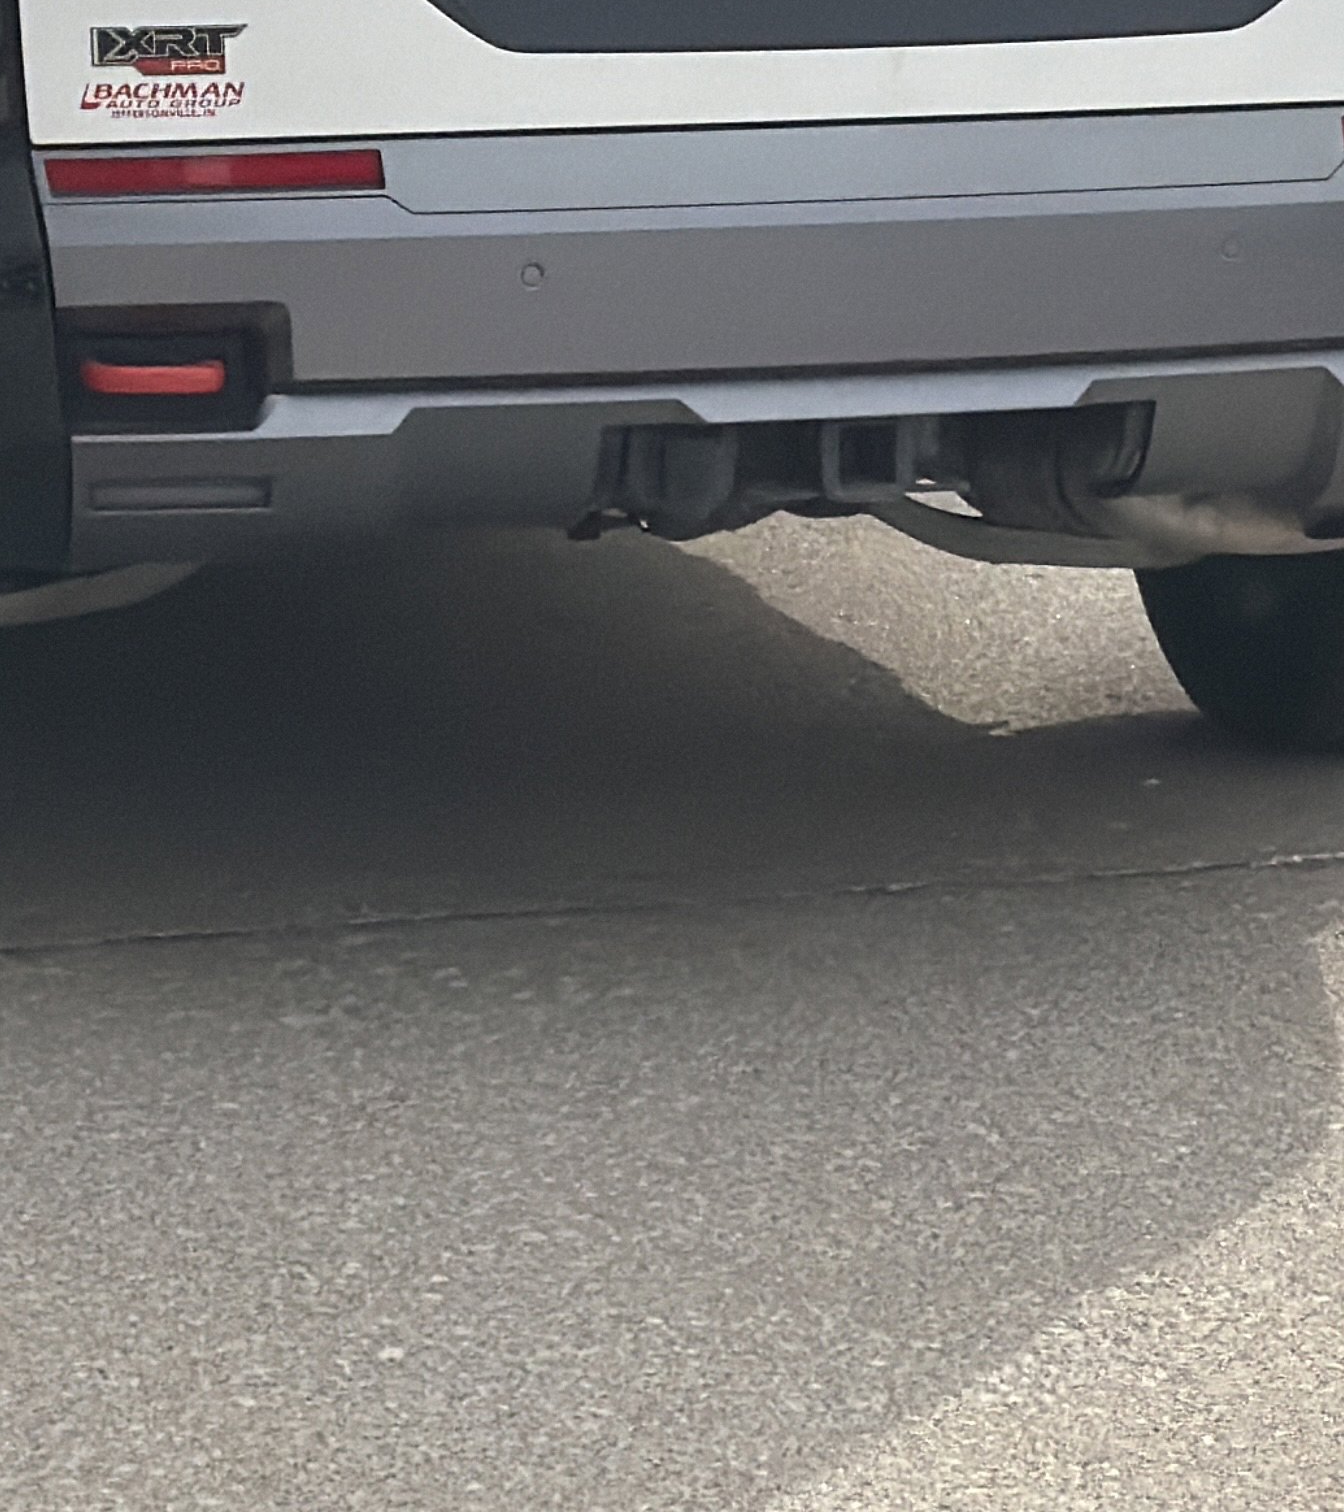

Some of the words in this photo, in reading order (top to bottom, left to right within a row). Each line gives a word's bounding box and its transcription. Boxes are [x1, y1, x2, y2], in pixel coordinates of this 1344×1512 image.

[90, 23, 248, 67] XRT
[171, 59, 221, 71] PRO
[94, 82, 245, 99] BACHMAN
[106, 99, 161, 109] AUTO
[170, 98, 241, 108] GROUP
